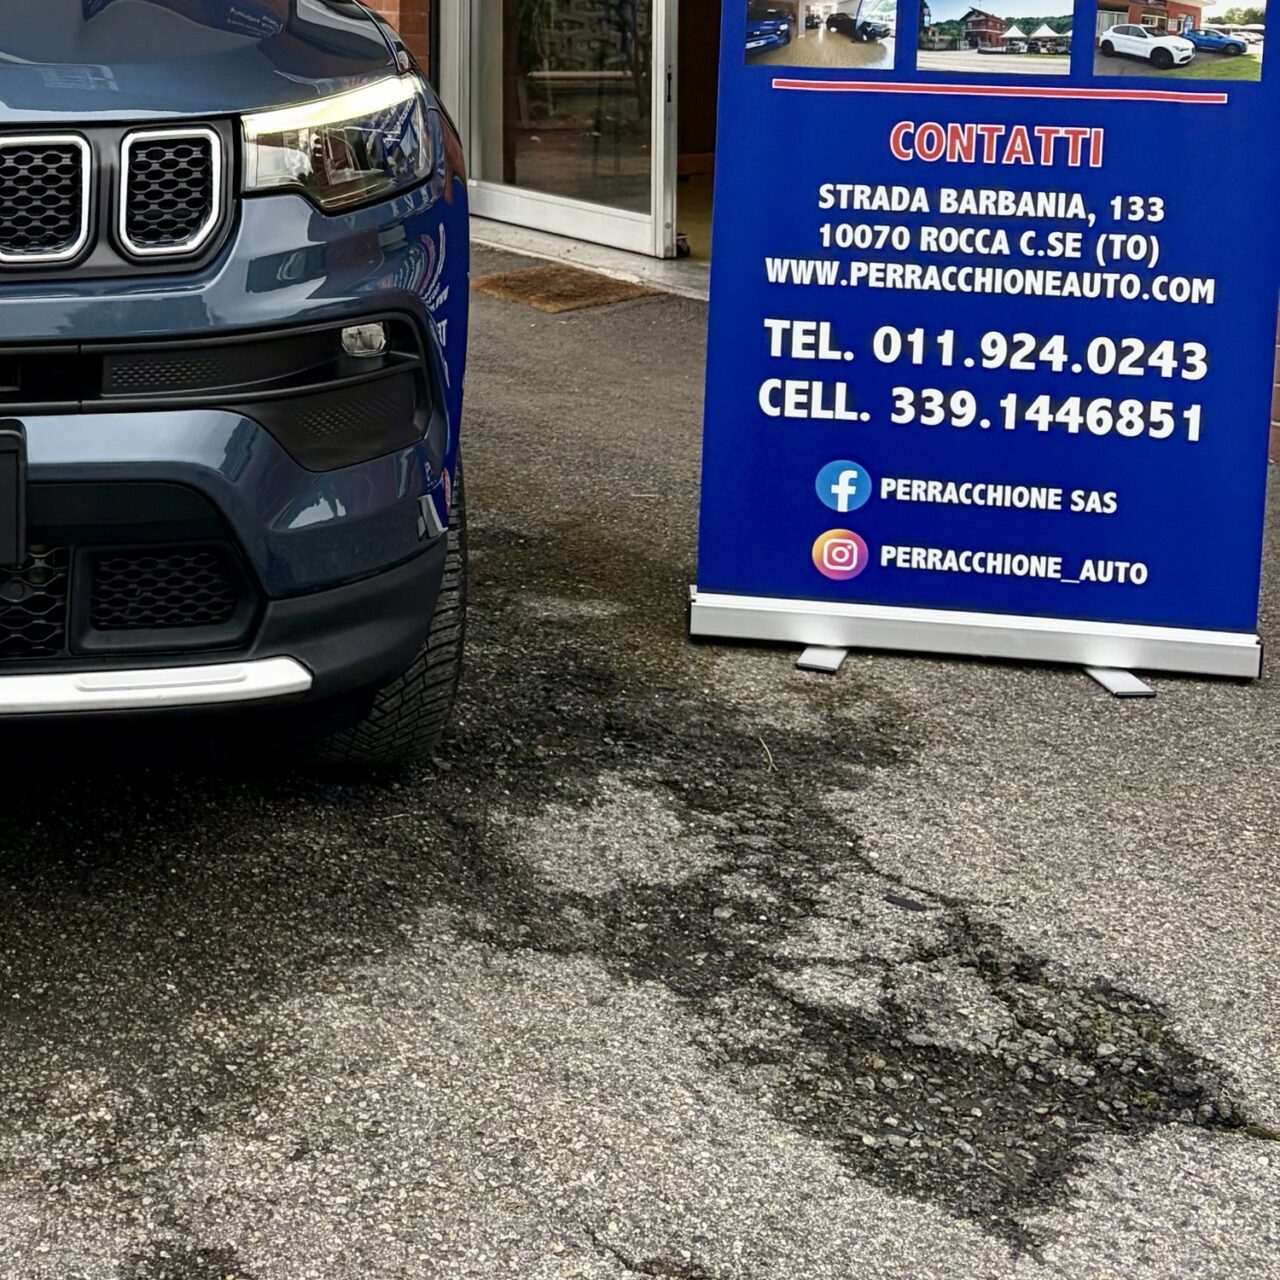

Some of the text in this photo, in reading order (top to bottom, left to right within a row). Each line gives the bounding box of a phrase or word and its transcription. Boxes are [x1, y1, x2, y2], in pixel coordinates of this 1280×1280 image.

[890, 121, 1104, 167] CONTATTI
[819, 184, 1164, 226] STRADA BARBANIA, 133
[820, 224, 1160, 268] 10070 ROCCA C.SE (TO)
[765, 257, 1215, 304] WWW.PERRACCHIONEAUTO.COM
[764, 319, 1208, 380] TEL. 011.924.0243
[758, 379, 1202, 442] CELL. 339.1446851
[881, 479, 1118, 514] PERRACCHIONE SAS
[881, 546, 1148, 585] PERRACCHIONE_AUTO
